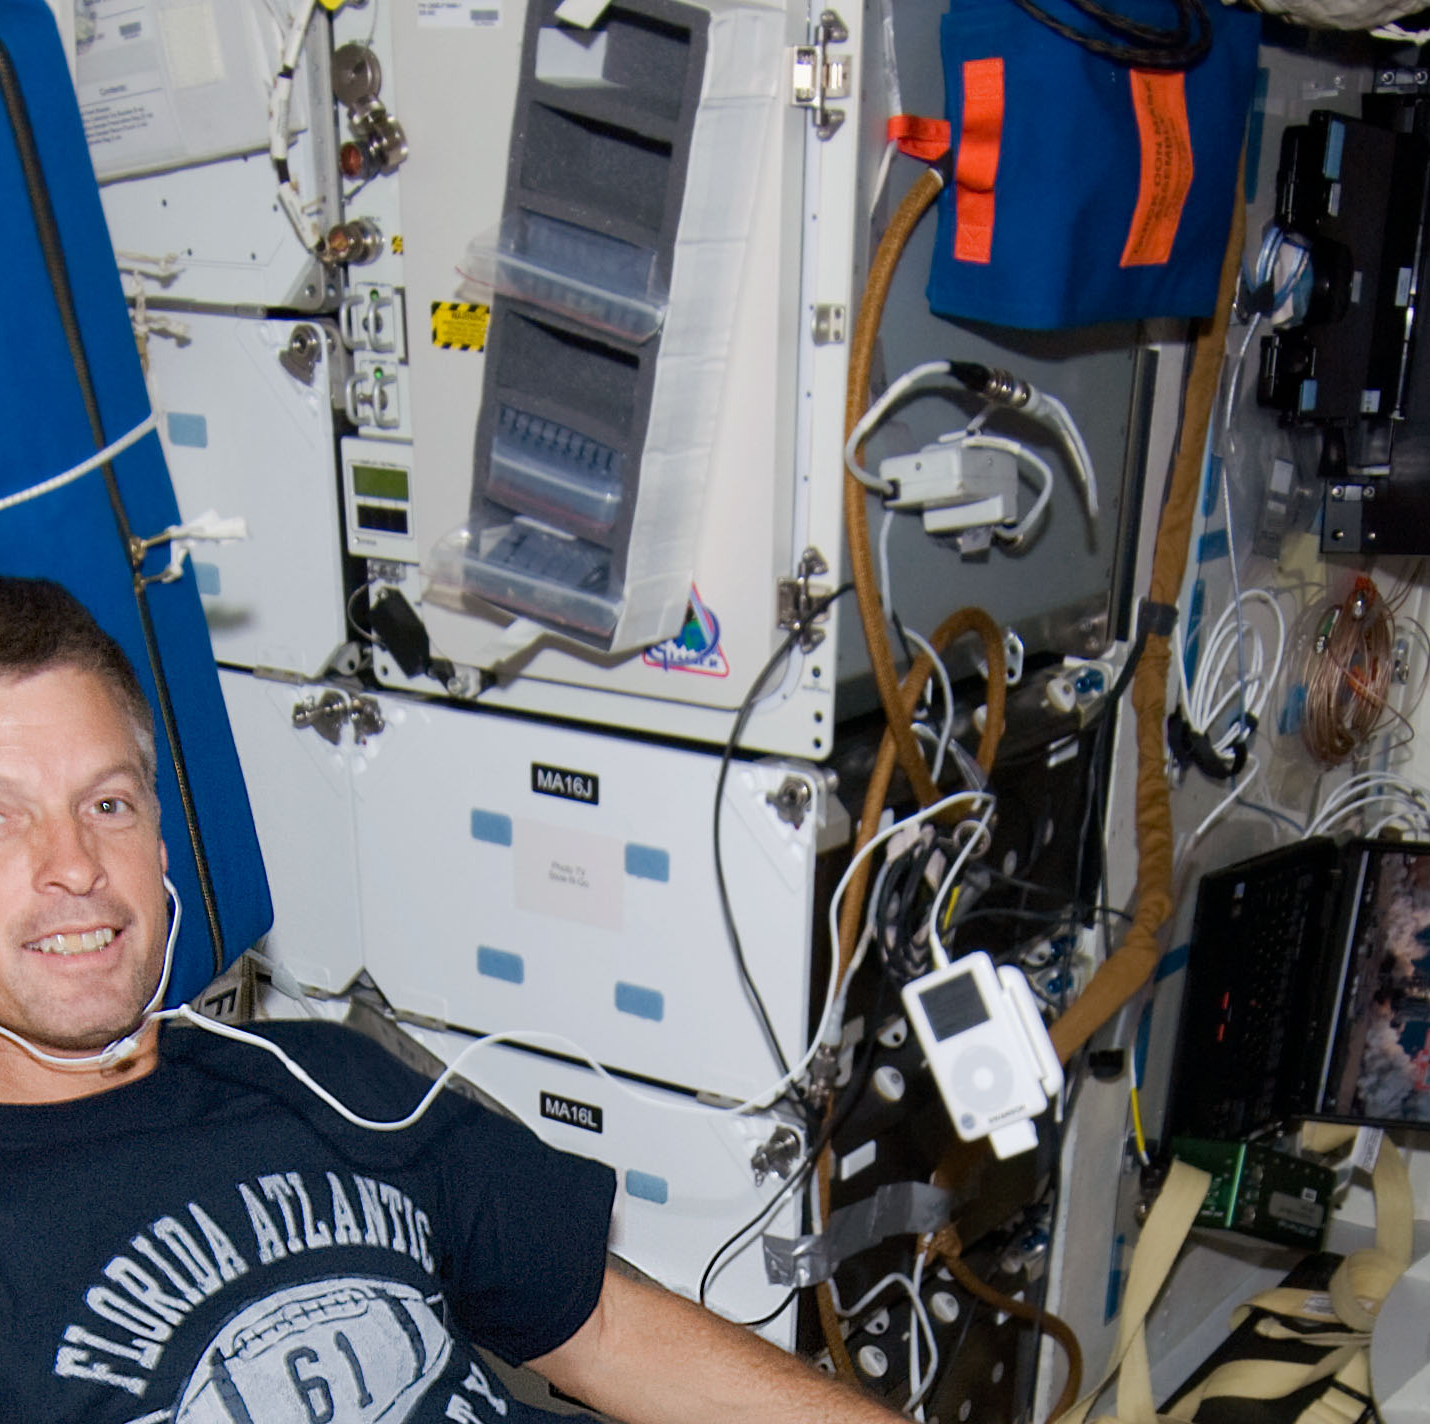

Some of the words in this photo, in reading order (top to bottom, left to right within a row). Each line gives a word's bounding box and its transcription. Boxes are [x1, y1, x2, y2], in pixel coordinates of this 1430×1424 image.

[536, 771, 594, 800] MA16J
[545, 1096, 599, 1129] MA16L
[53, 1202, 250, 1398] FLORIDA
[236, 1170, 436, 1276] ATLANTIC
